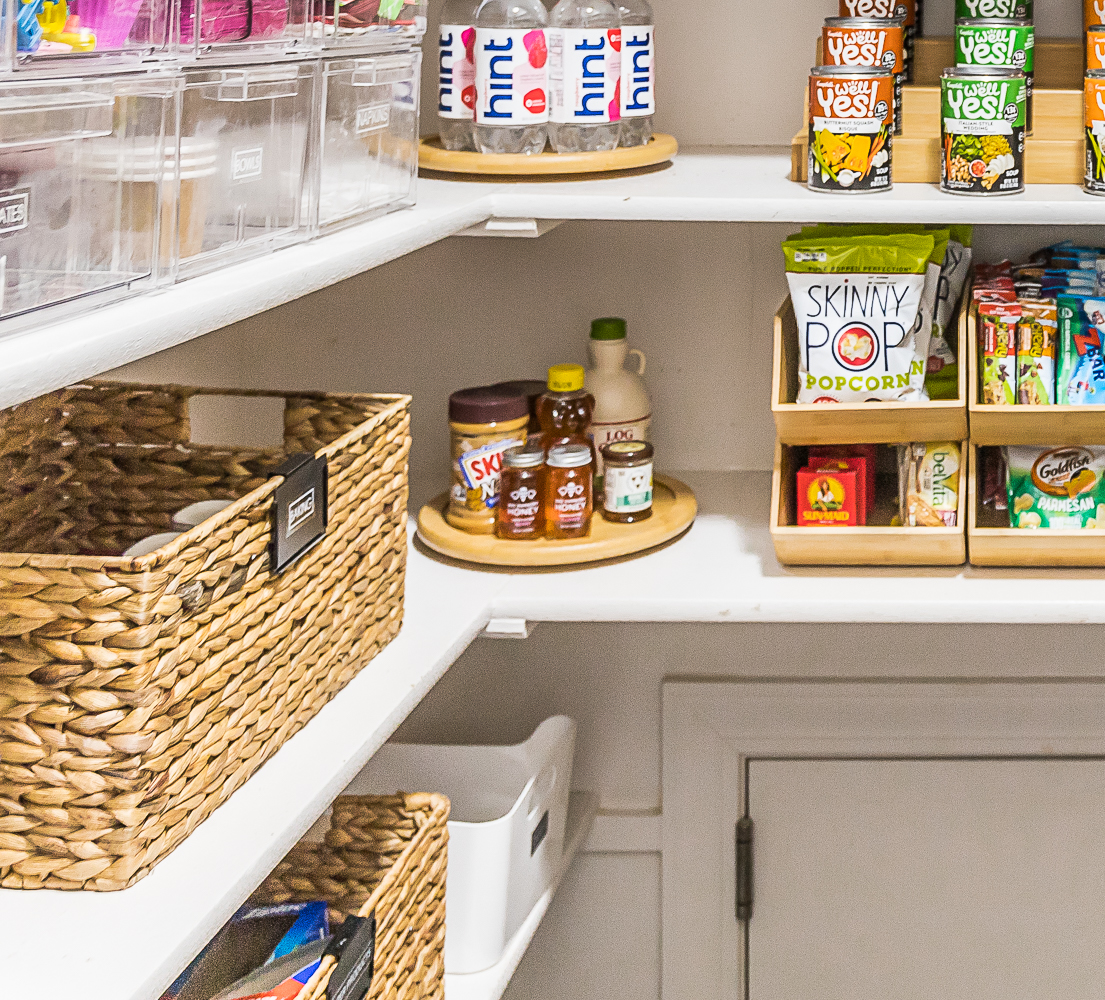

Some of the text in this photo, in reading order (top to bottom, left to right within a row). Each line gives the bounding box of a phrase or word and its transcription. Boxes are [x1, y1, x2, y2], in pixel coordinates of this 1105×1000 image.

[843, 30, 879, 44] well
[959, 29, 1016, 66] Yes!
[975, 29, 1010, 44] well
[827, 30, 885, 67] Yes!
[483, 36, 513, 119] hint
[574, 36, 606, 117] hint
[625, 32, 651, 111] hint
[817, 80, 879, 118] Yes!
[834, 81, 872, 95] well
[963, 82, 1001, 97] well
[947, 82, 1008, 120] Yes!
[358, 106, 388, 128] NAPKINS
[235, 153, 262, 176] BOWLS
[876, 166, 889, 175] SOUP
[1005, 169, 1020, 178] SOUP
[805, 321, 906, 372] POP
[1085, 346, 1105, 381] BAR
[805, 373, 910, 392] POPCORN
[606, 429, 634, 442] LOG
[1039, 455, 1090, 479] Goldfish
[932, 452, 950, 507] belVita
[507, 506, 539, 517] HONEY
[554, 502, 587, 512] HONEY
[1036, 496, 1095, 513] PARMESAN
